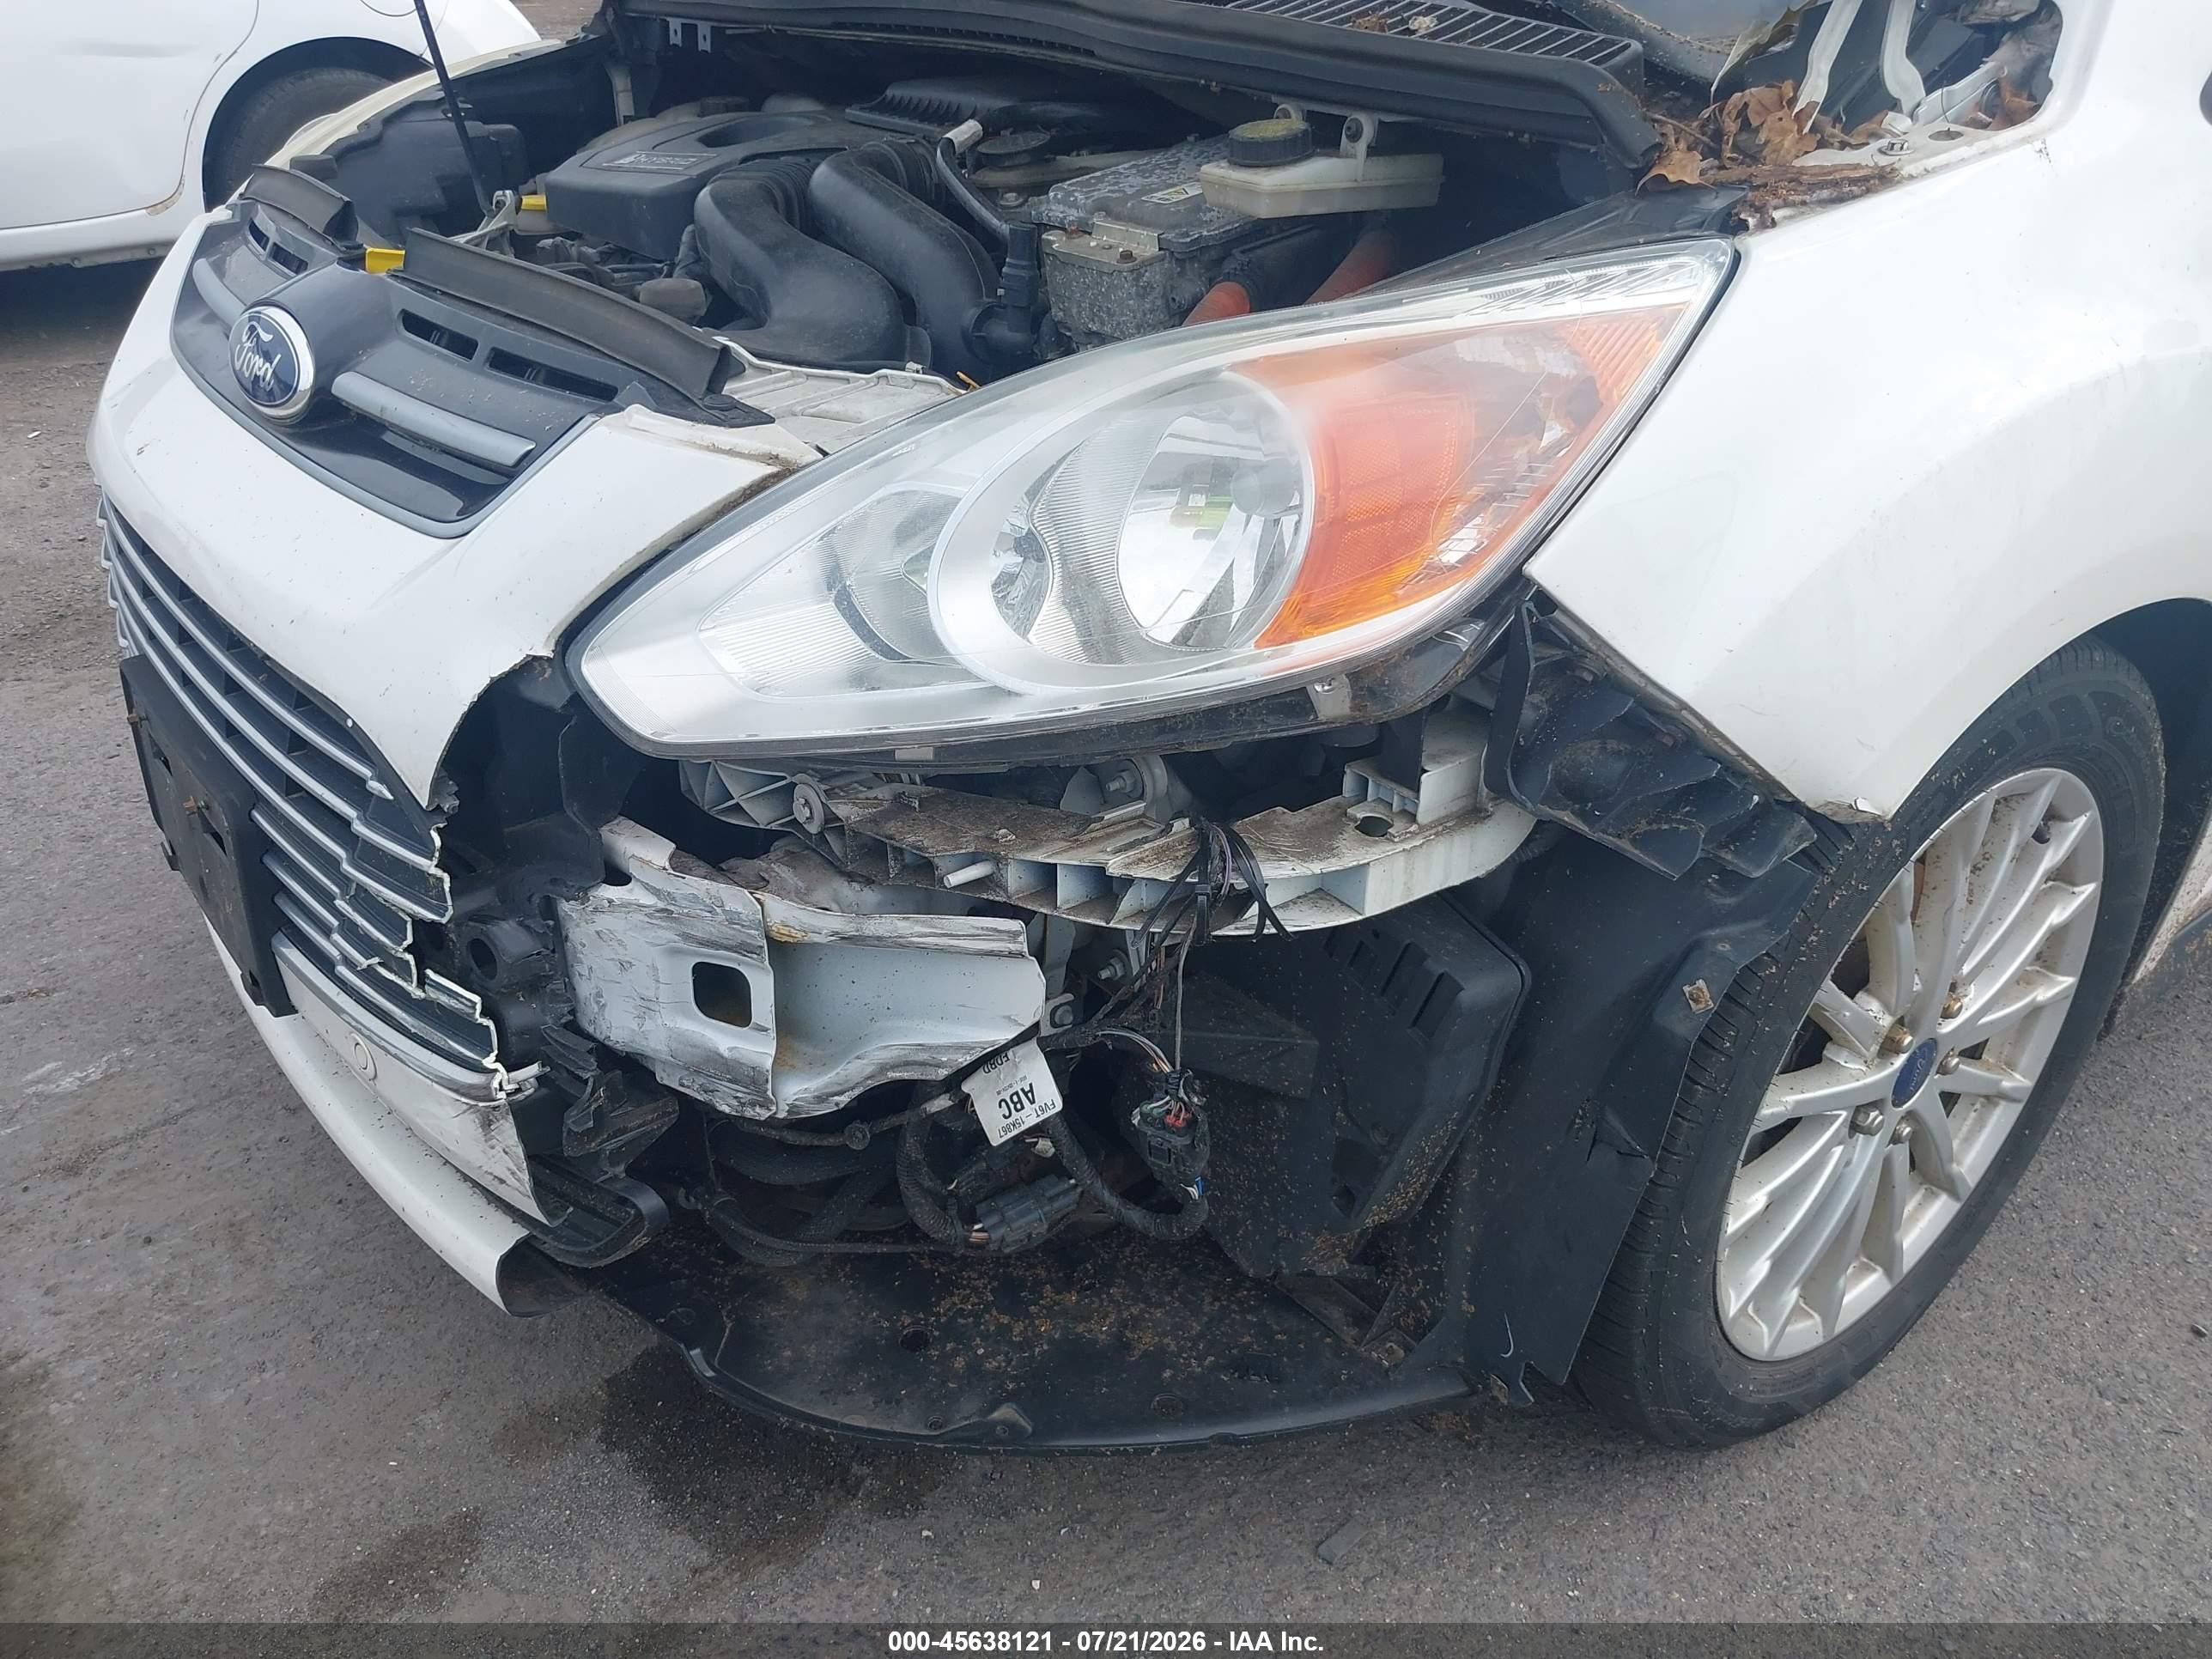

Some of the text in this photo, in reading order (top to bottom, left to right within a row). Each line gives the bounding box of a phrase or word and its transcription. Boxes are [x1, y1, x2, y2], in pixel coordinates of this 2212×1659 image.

[234, 321, 282, 392] Ford
[998, 1082, 1036, 1120] ABC
[1034, 1099, 1056, 1119] FV6T
[998, 1115, 1025, 1139] 15K867
